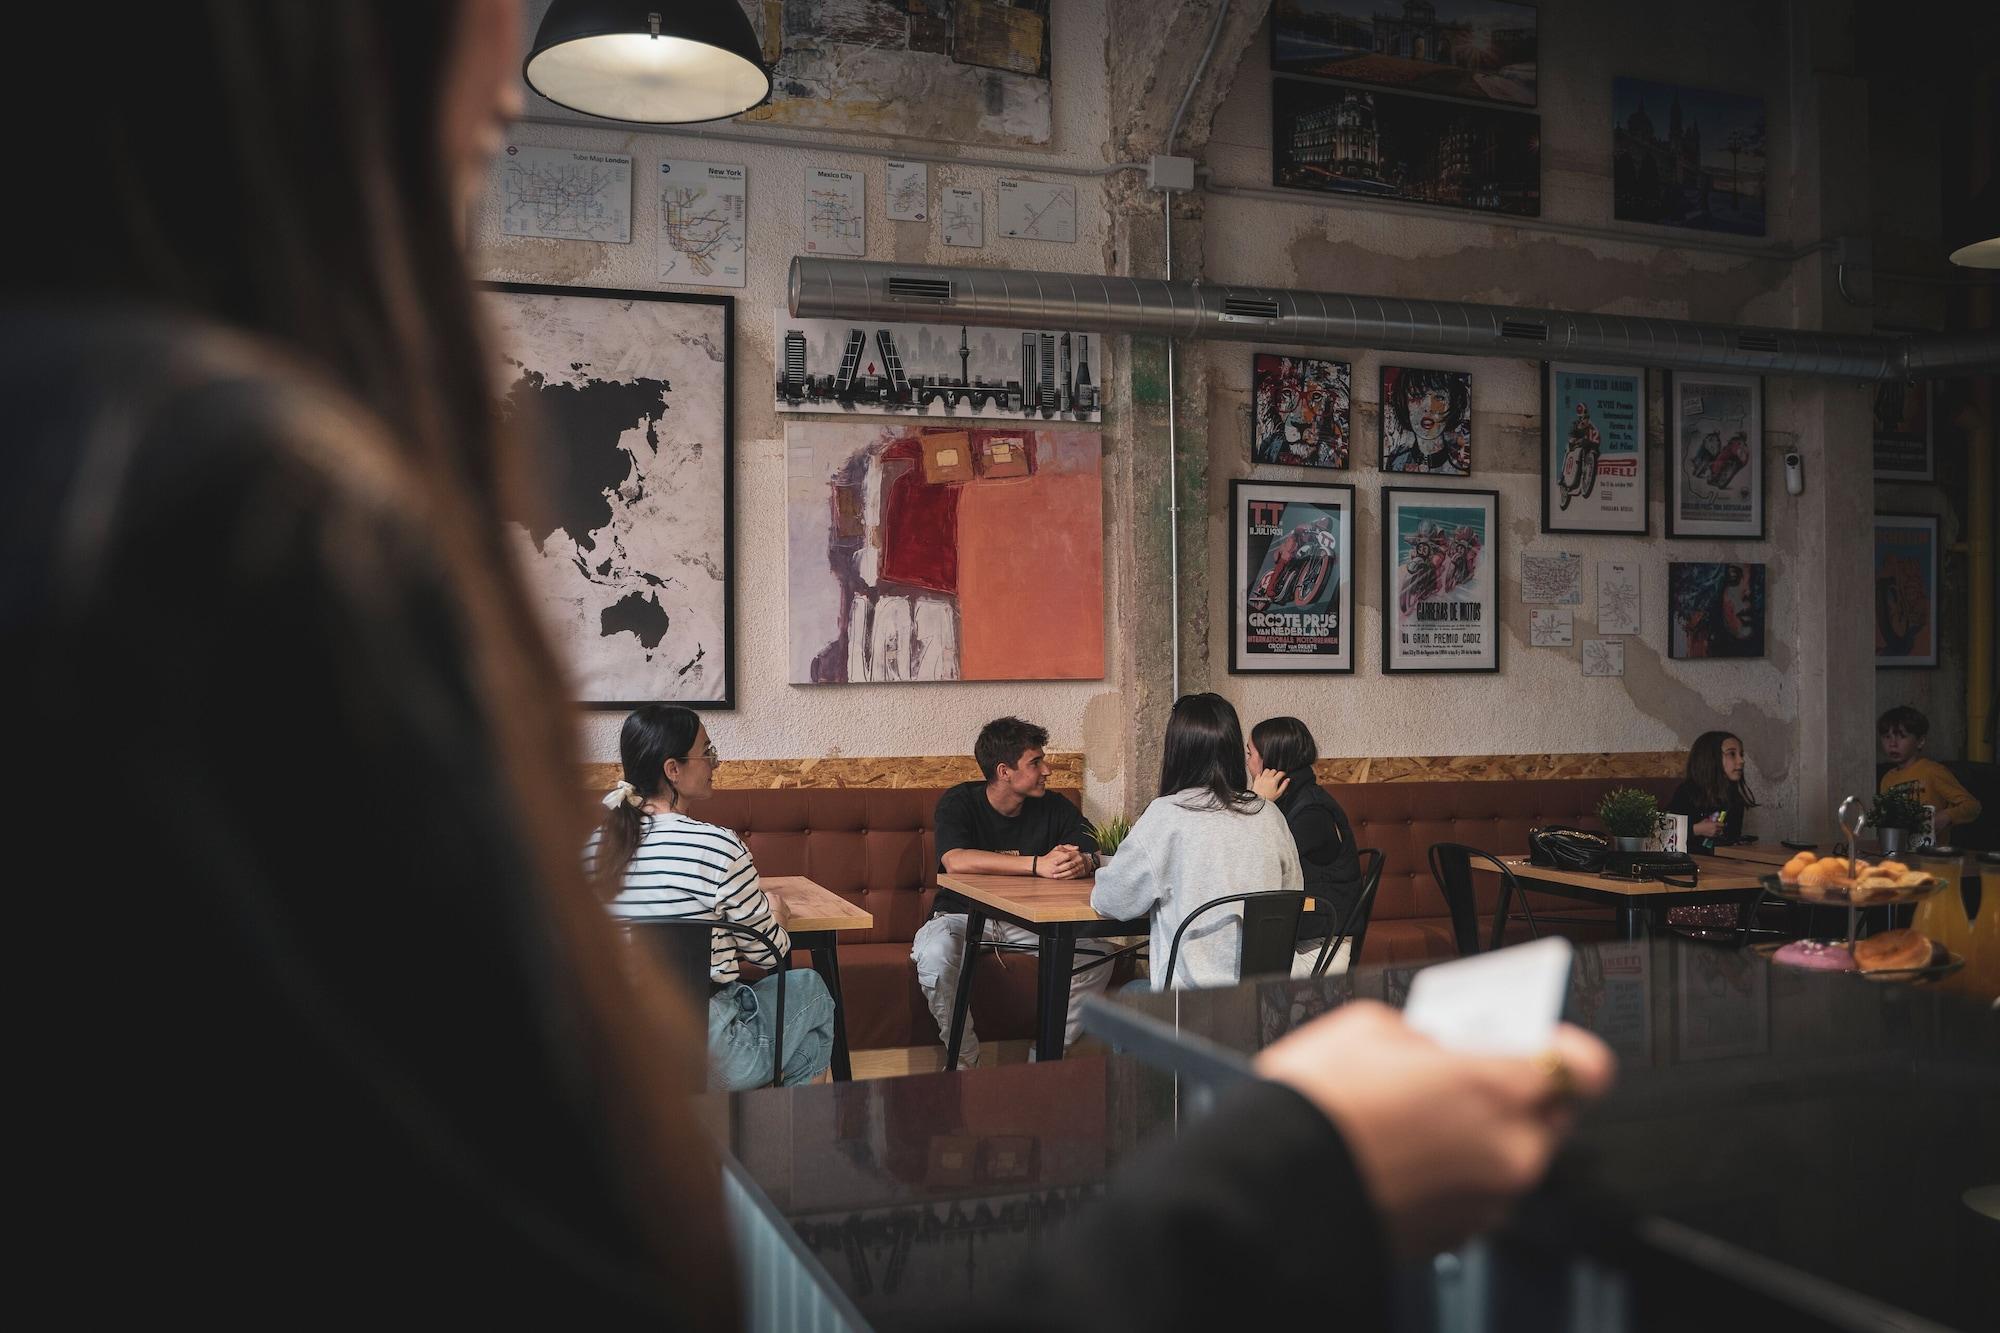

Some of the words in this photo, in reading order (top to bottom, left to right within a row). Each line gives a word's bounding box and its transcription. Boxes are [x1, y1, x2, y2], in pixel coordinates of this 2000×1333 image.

[590, 155, 604, 163] Map
[1417, 602, 1448, 621] CARRERAS
[1450, 602, 1458, 621] DE
[1460, 602, 1481, 621] MOTOS
[1248, 612, 1302, 628] GROOTE
[1271, 627, 1329, 637] NEDERLAND
[1413, 633, 1430, 644] GRAN
[1434, 633, 1458, 644] PREMIO
